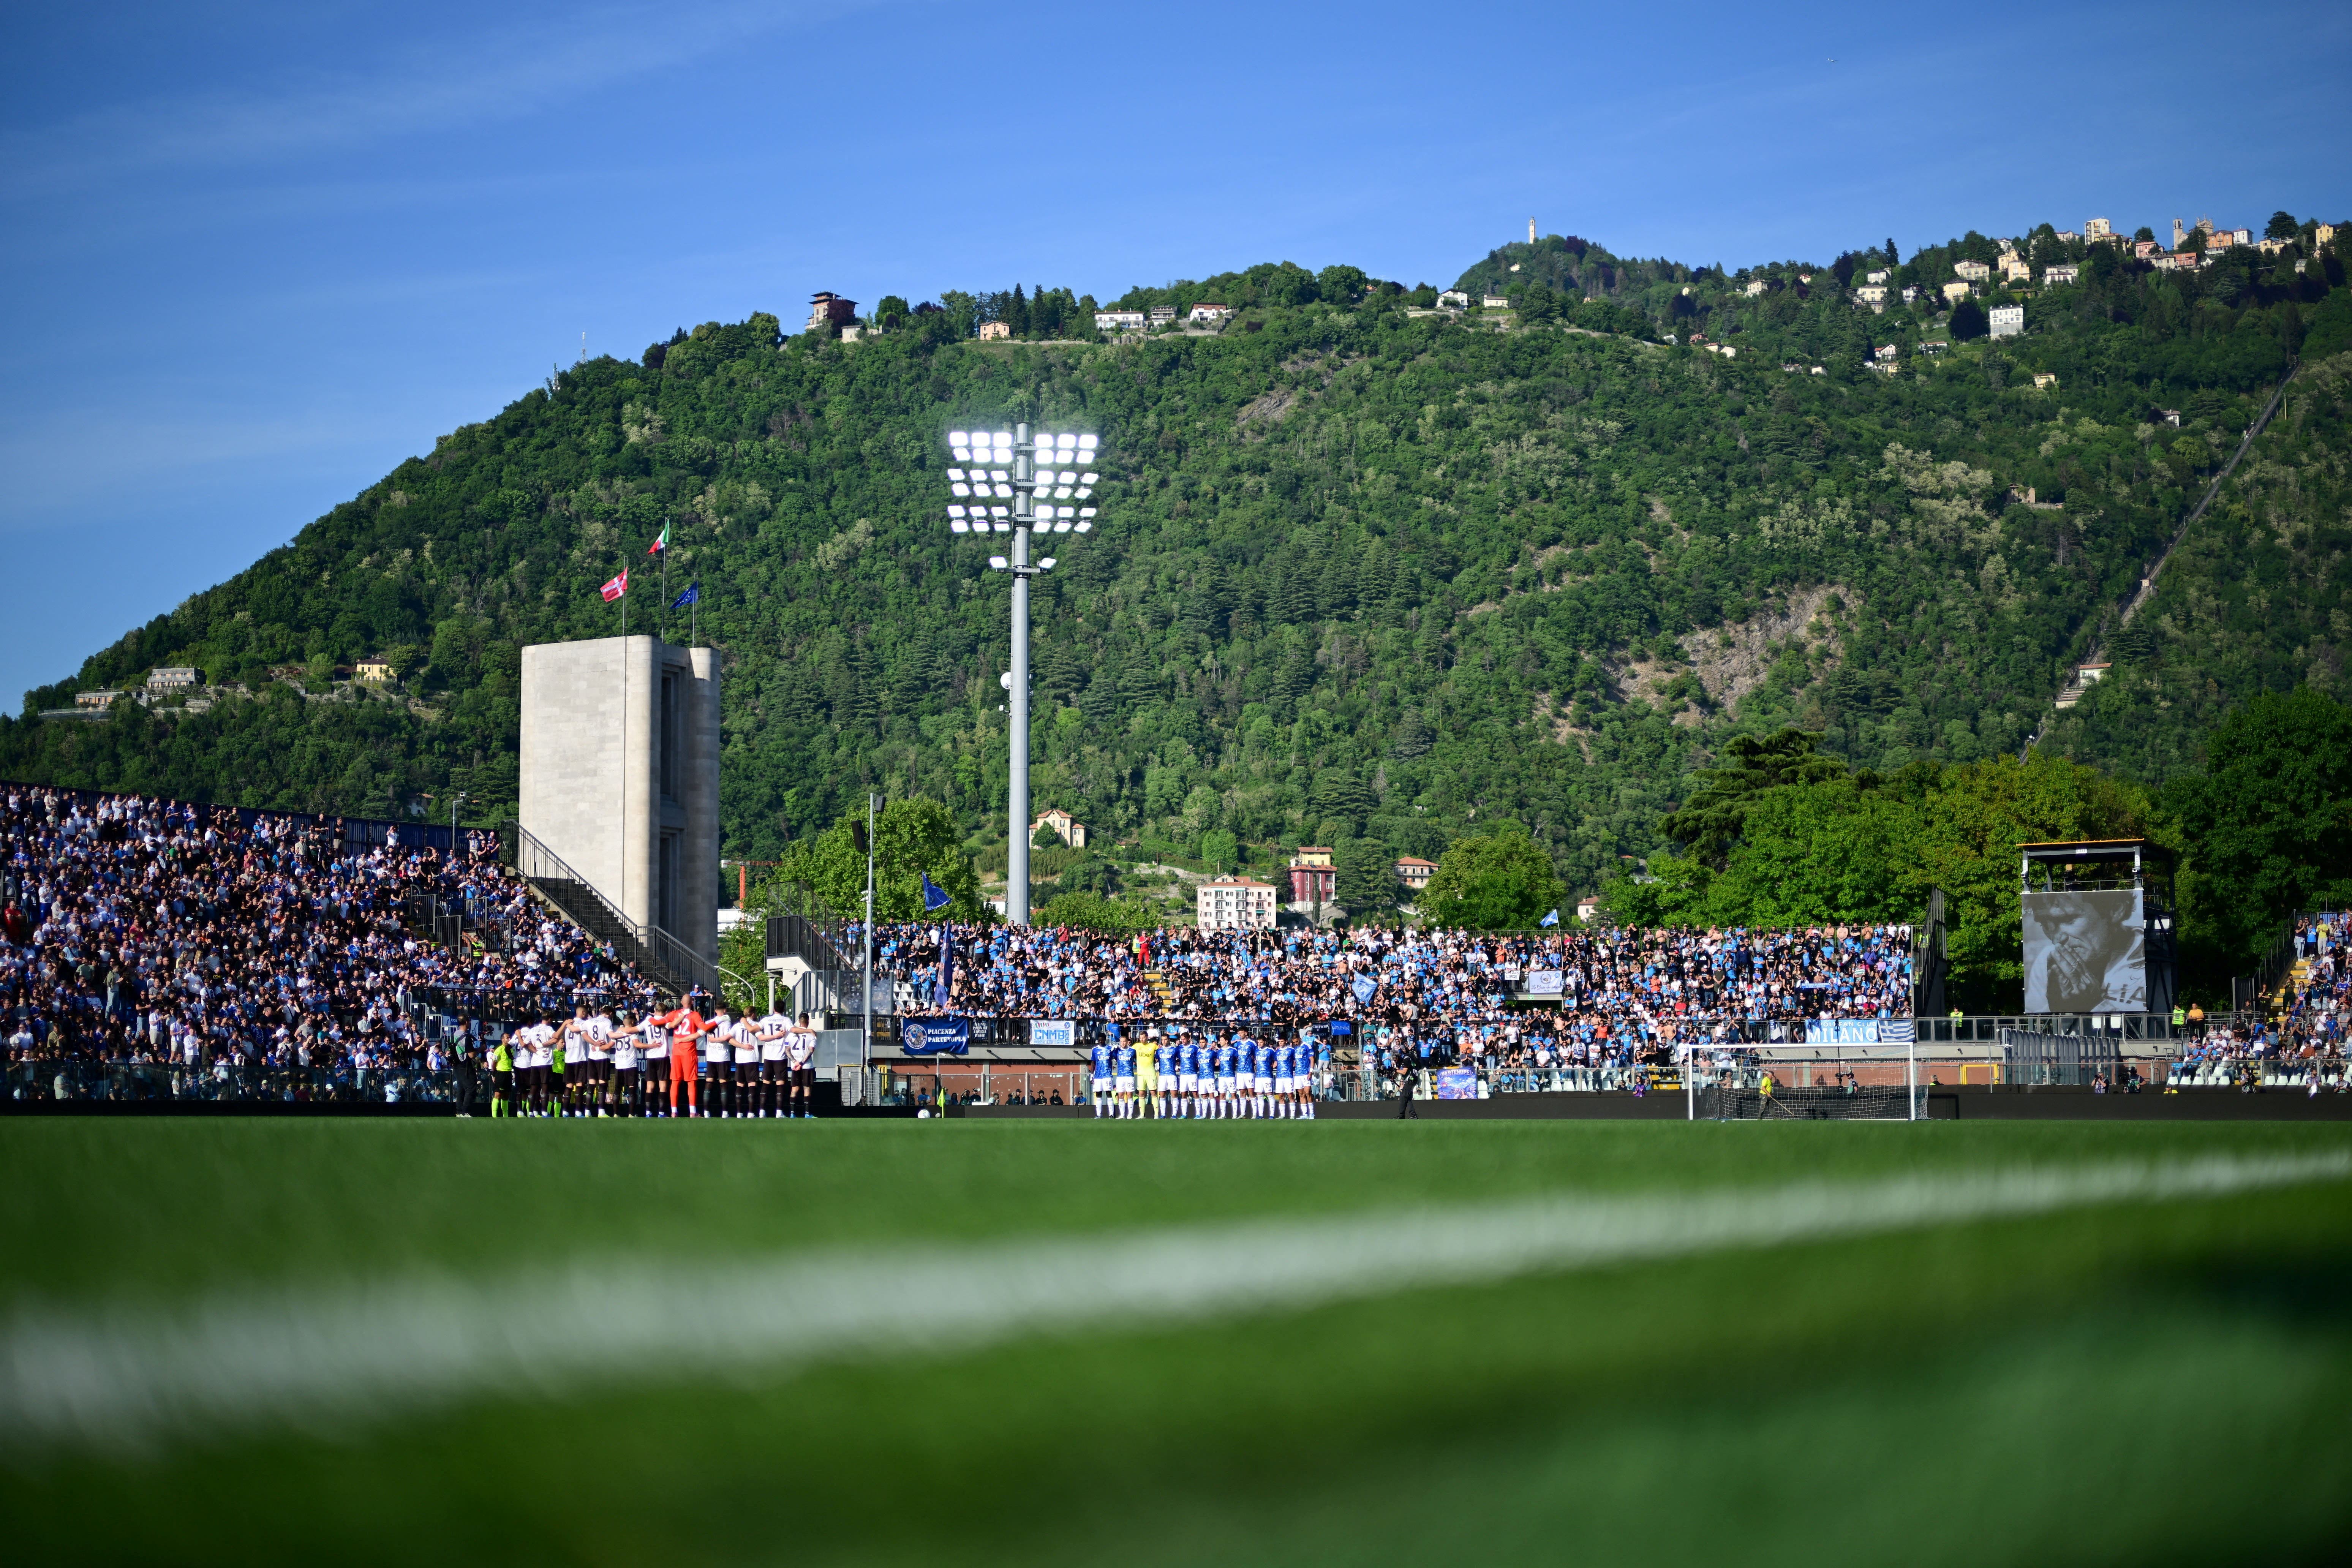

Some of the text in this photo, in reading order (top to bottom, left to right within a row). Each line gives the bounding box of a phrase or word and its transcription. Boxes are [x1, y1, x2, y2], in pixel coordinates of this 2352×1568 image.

[568, 1032, 574, 1042] 4
[592, 1025, 598, 1040] 8
[648, 1024, 662, 1040] 19
[741, 1028, 749, 1043] 11
[768, 1023, 782, 1037] 13
[1034, 1029, 1065, 1040] CNMB
[1807, 1027, 1877, 1043] MILANO
[615, 1037, 631, 1051] 68
[792, 1035, 806, 1051] 21
